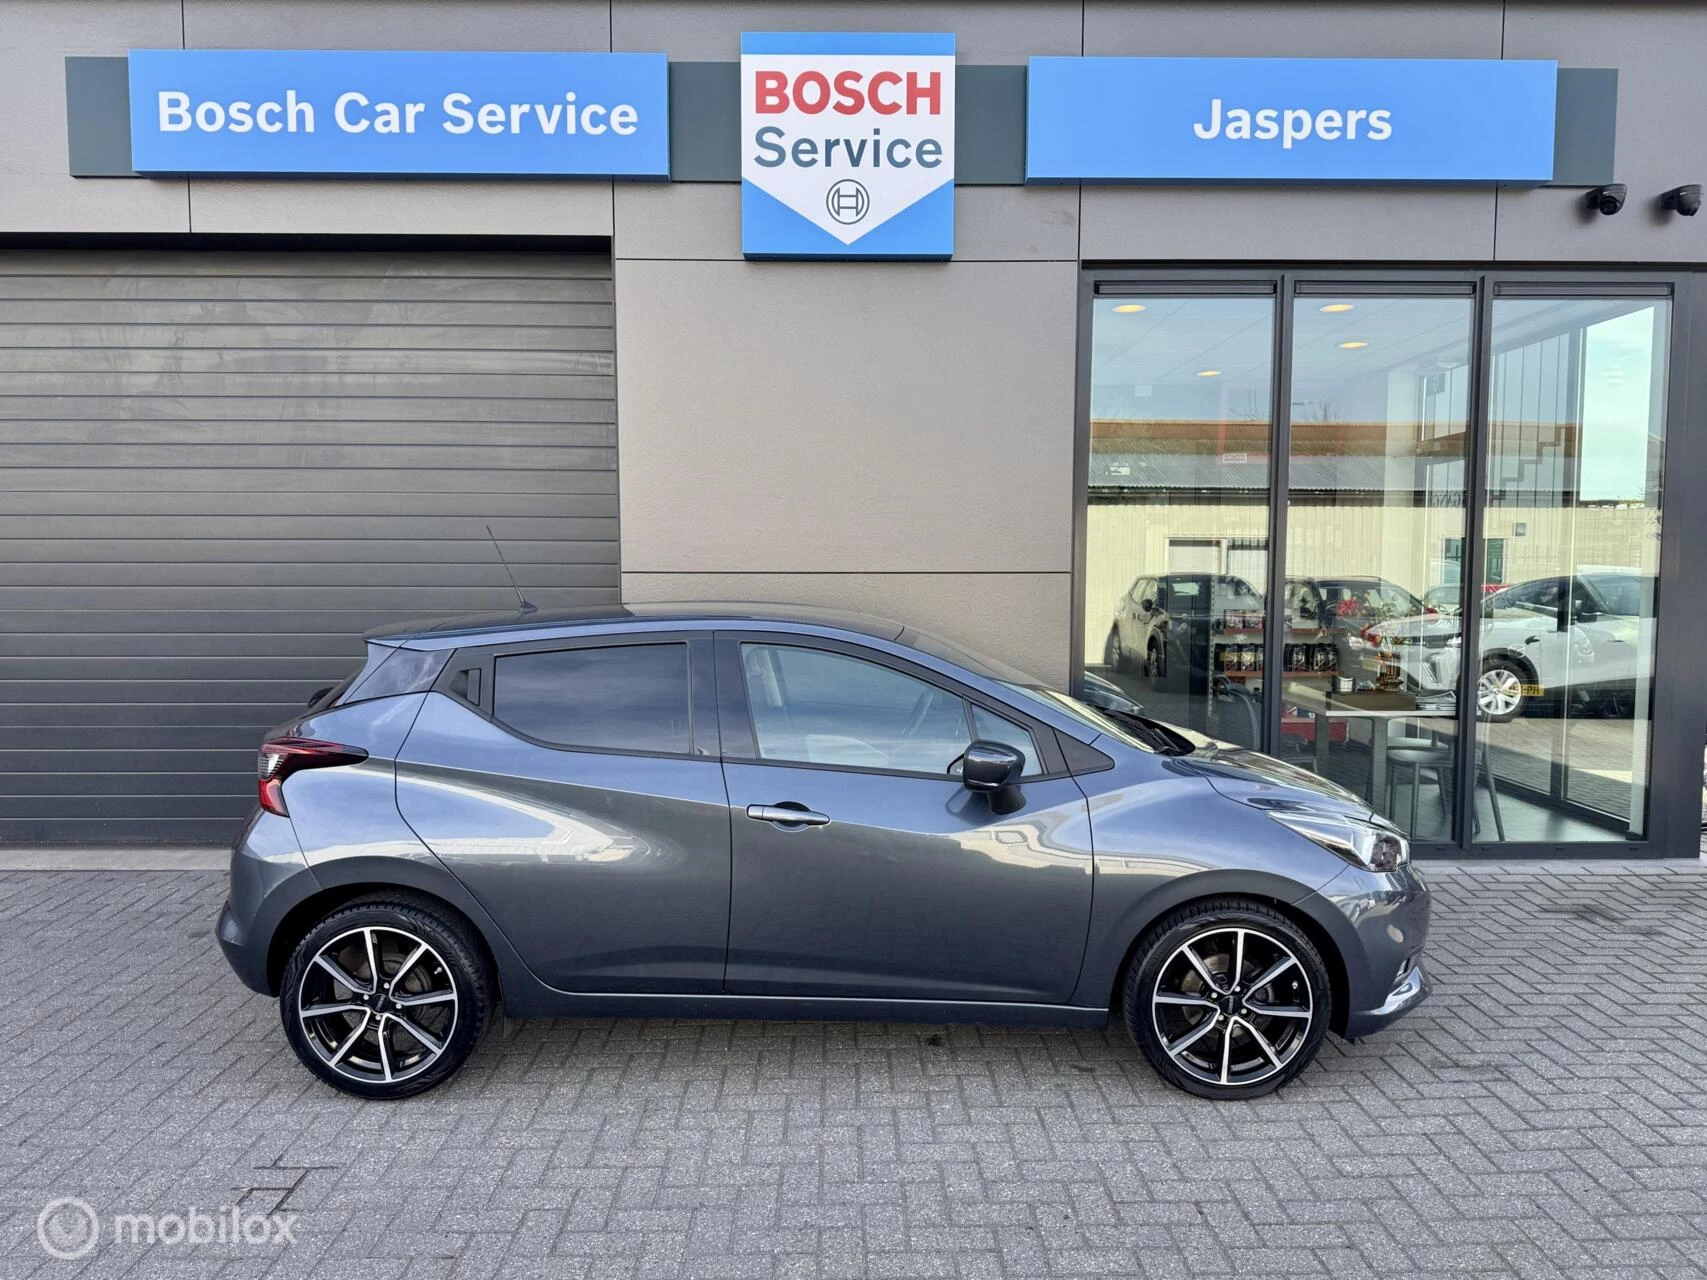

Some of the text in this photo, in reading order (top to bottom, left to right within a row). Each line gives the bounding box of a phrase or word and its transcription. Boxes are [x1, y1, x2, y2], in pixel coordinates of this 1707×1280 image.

[158, 89, 638, 136] Bosch Car Service
[755, 70, 941, 116] BOSCH
[753, 125, 943, 169] Service
[1193, 98, 1393, 150] Jaspers
